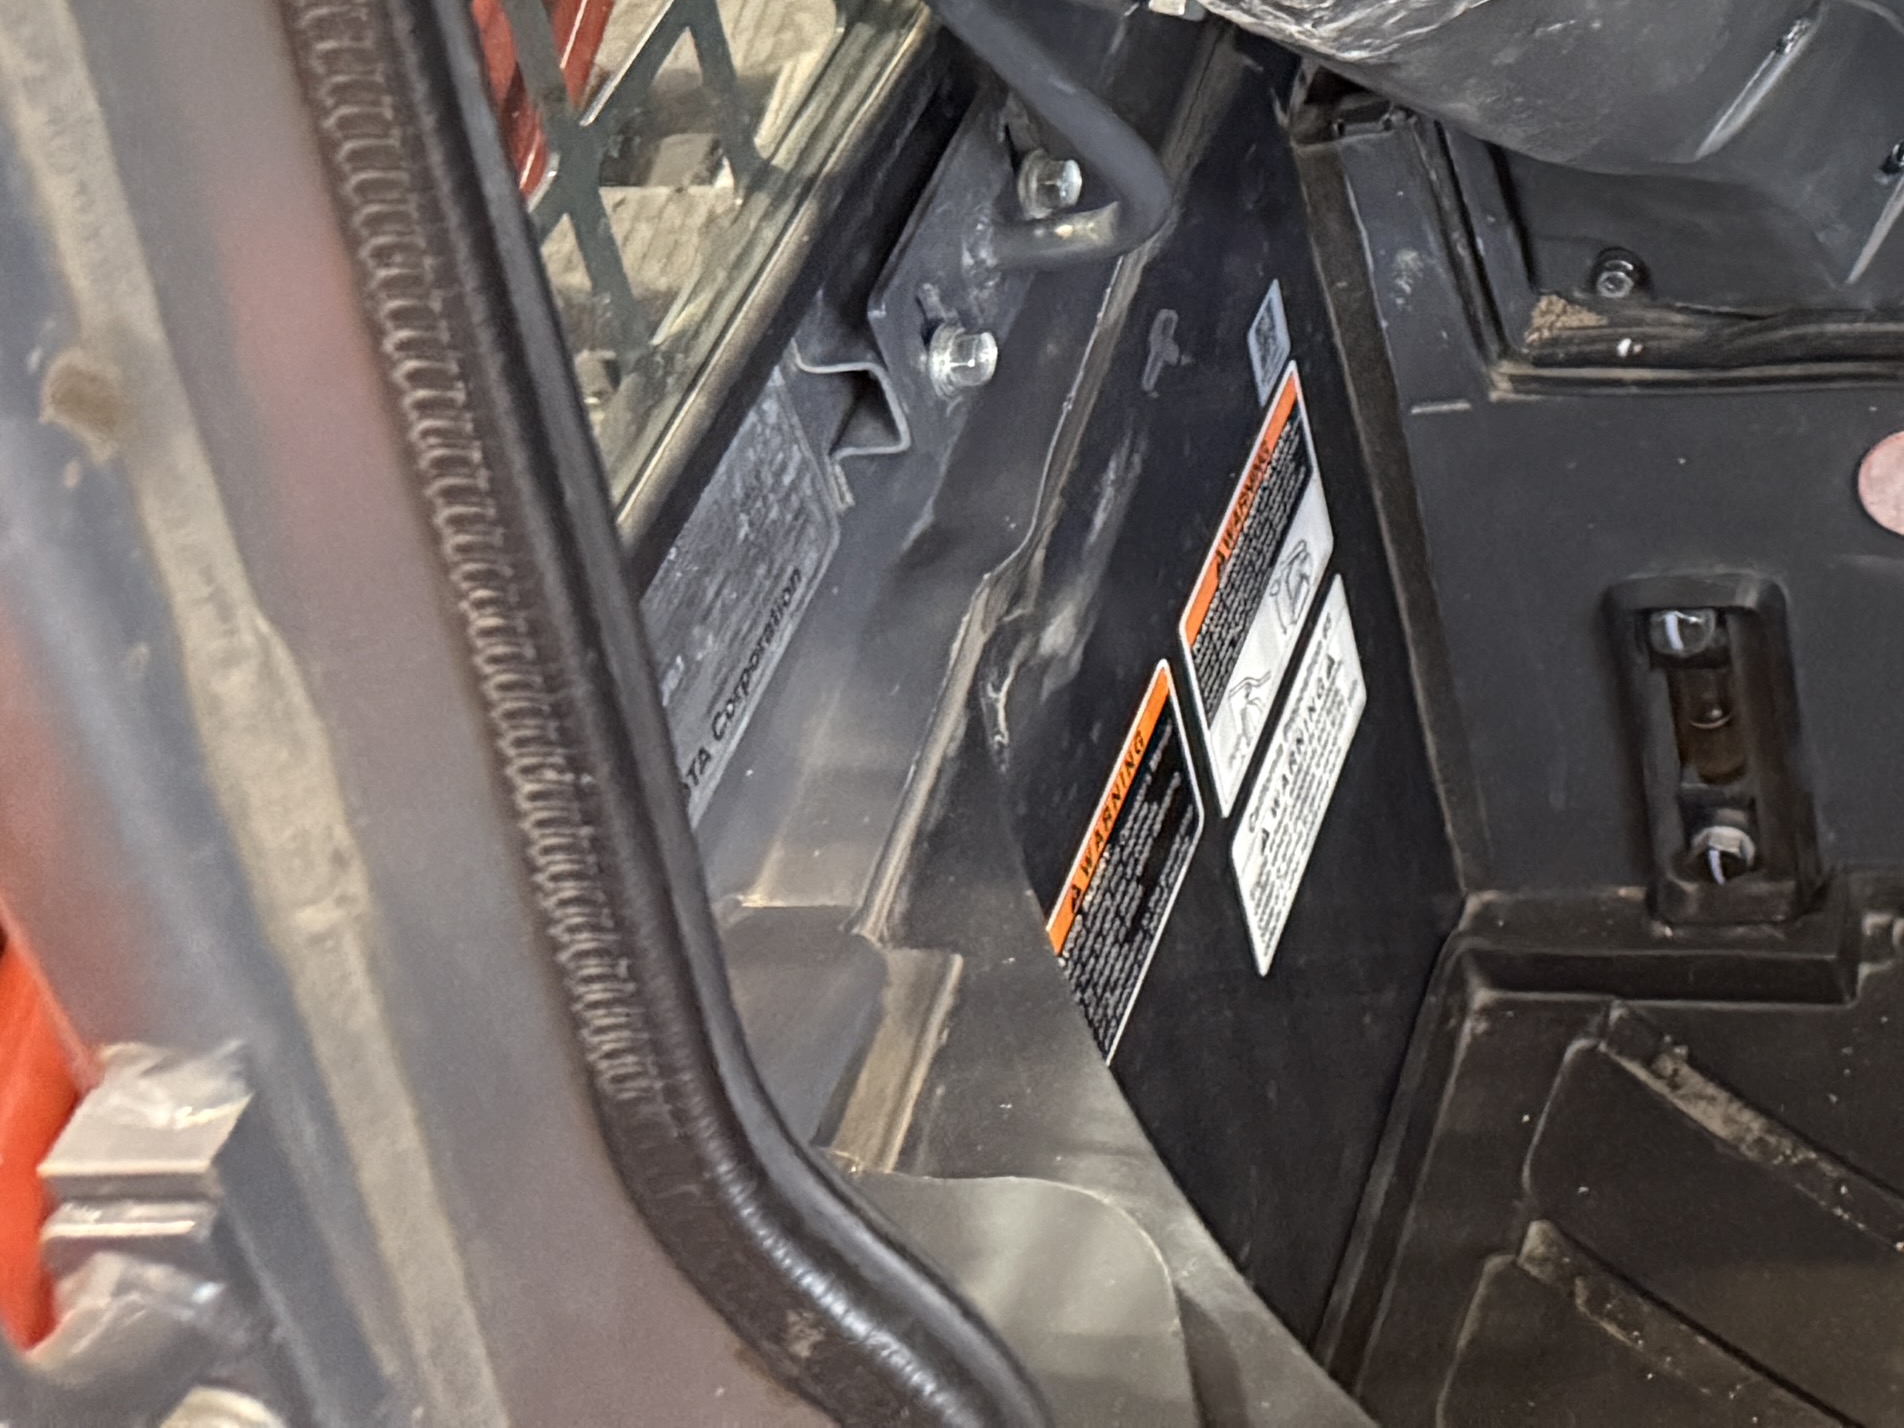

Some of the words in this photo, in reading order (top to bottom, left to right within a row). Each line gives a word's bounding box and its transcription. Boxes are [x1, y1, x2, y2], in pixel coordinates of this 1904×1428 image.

[710, 568, 803, 743] Corporation
[1080, 727, 1144, 880] WARNING
[1269, 672, 1325, 821] WARNING
